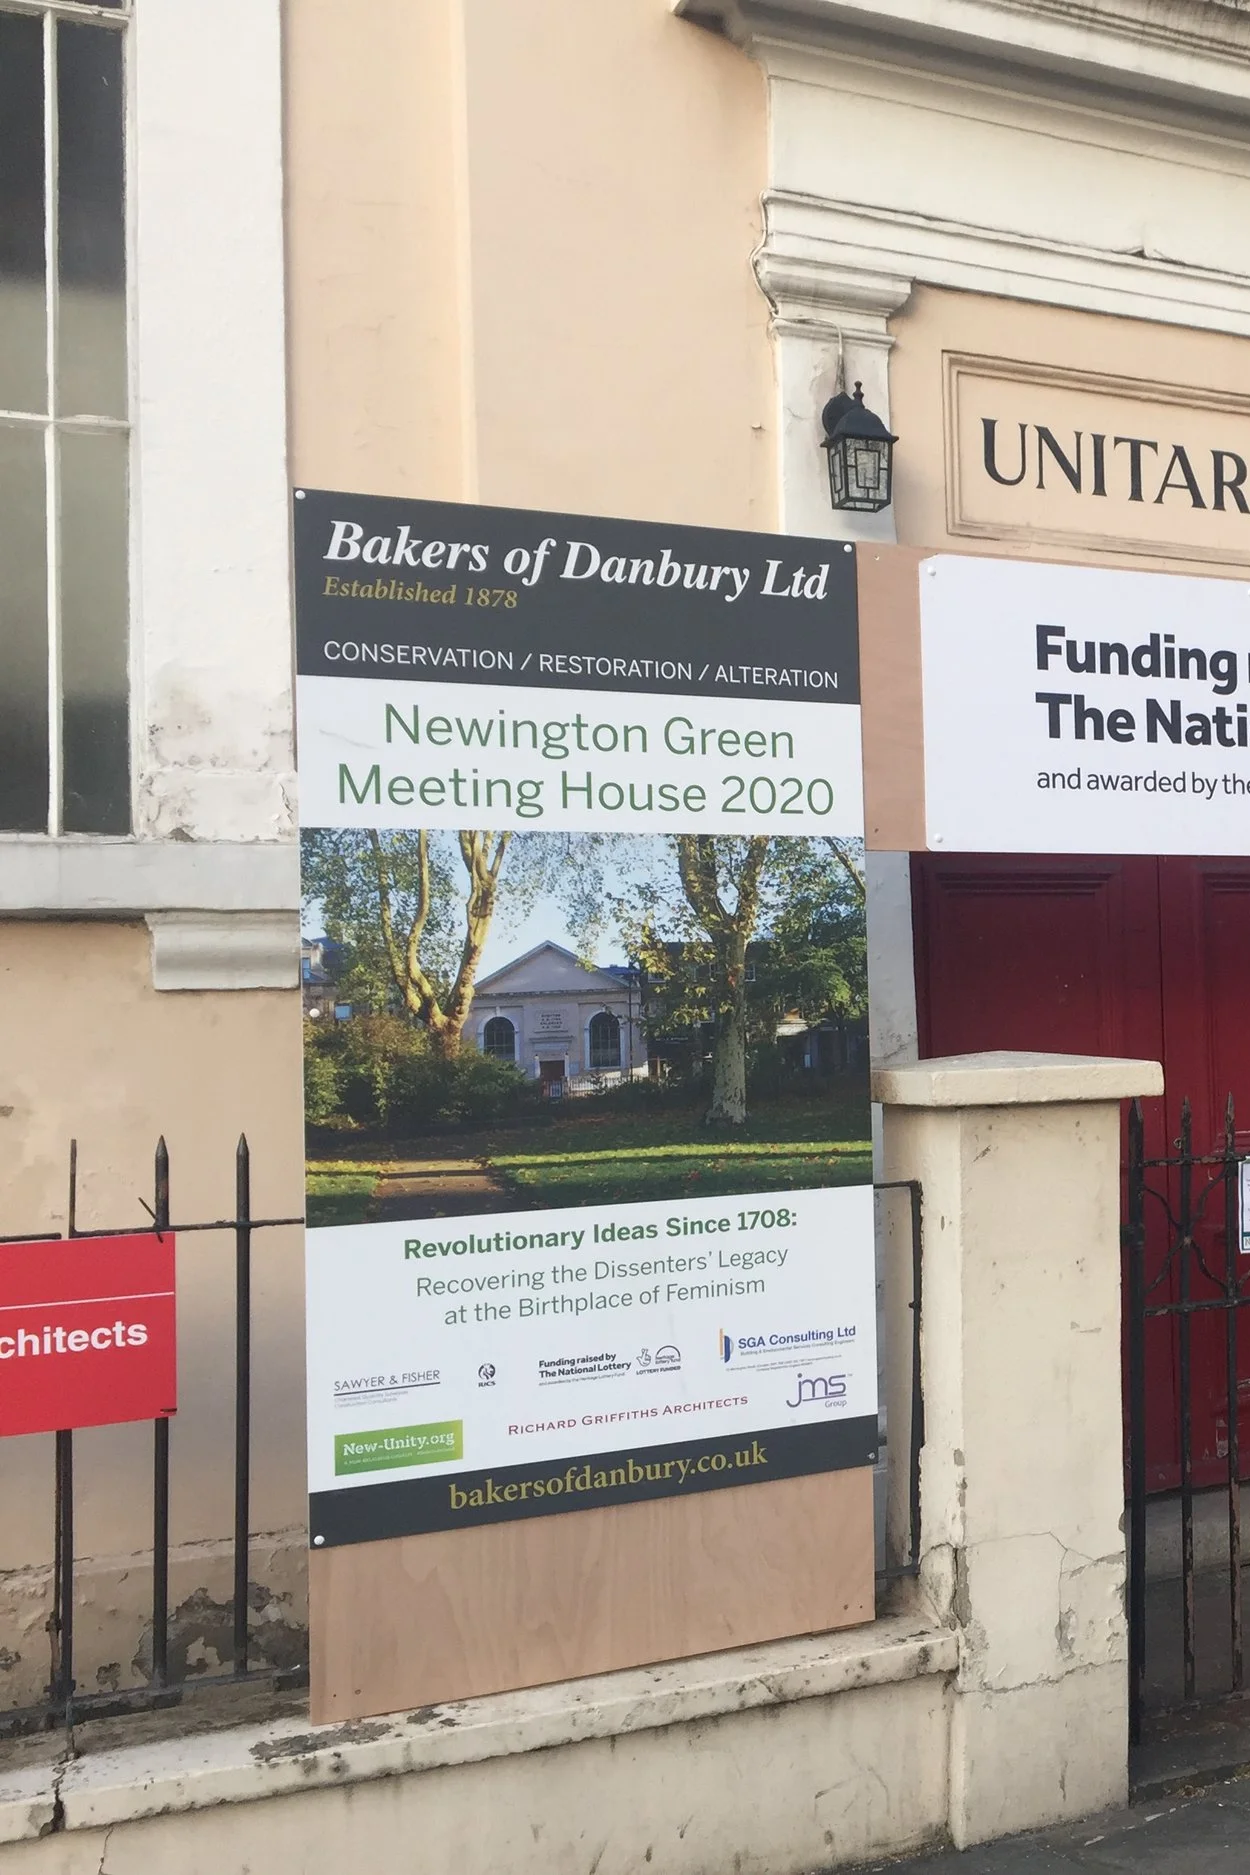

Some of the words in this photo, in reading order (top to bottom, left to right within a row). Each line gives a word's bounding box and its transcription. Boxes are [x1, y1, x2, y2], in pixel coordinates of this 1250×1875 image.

[323, 520, 489, 572] Bakers
[504, 537, 556, 587] of
[560, 540, 749, 602] Danbury
[760, 559, 831, 600] Ltd
[324, 575, 456, 605] Established
[465, 587, 518, 609] 1878
[324, 641, 514, 670] CONSERVATION
[540, 654, 692, 681] RESTORATION
[714, 665, 838, 689] ALTERATION
[1036, 624, 1238, 696] Funding
[385, 703, 648, 759] Newington
[664, 716, 794, 759] Green
[1036, 692, 1135, 743] The
[338, 764, 544, 818] Meeting
[561, 771, 706, 813] House
[720, 776, 834, 816] 2020
[1036, 768, 1082, 790] and
[1087, 770, 1186, 794] awarded
[1191, 772, 1218, 800] by
[404, 1222, 584, 1260] Revolutionary
[594, 1217, 658, 1244] Ideas
[666, 1212, 731, 1238] Since
[737, 1208, 798, 1231] 1708:
[416, 1268, 544, 1298] Recovering
[552, 1263, 587, 1285] the
[718, 1247, 789, 1275] Legacy
[444, 1304, 470, 1325] at
[474, 1298, 511, 1322] the
[519, 1289, 632, 1323] Birthplace
[639, 1282, 660, 1305] of
[666, 1276, 765, 1301] Feminism
[738, 1336, 766, 1350] SGA
[769, 1330, 834, 1346] Consulting
[837, 1326, 856, 1337] Ltd
[334, 1375, 385, 1391] SAWYER
[389, 1374, 398, 1384] &
[402, 1370, 440, 1383] FISHER
[539, 1358, 576, 1368] Funding
[577, 1354, 604, 1364] raised
[606, 1353, 616, 1362] by
[539, 1370, 556, 1378] The
[558, 1366, 596, 1376] National
[598, 1362, 632, 1372] Lottery
[636, 1368, 660, 1376] LOTTERY
[786, 1373, 846, 1408] jms
[825, 1400, 847, 1408] Group
[508, 1418, 576, 1436] RICHARD
[581, 1406, 658, 1426] GRIFFITHS
[662, 1396, 748, 1416] ARCHITECTS
[343, 1432, 454, 1456] New-Unity.org
[450, 1441, 768, 1511] bakersofdanbury.co.uk
